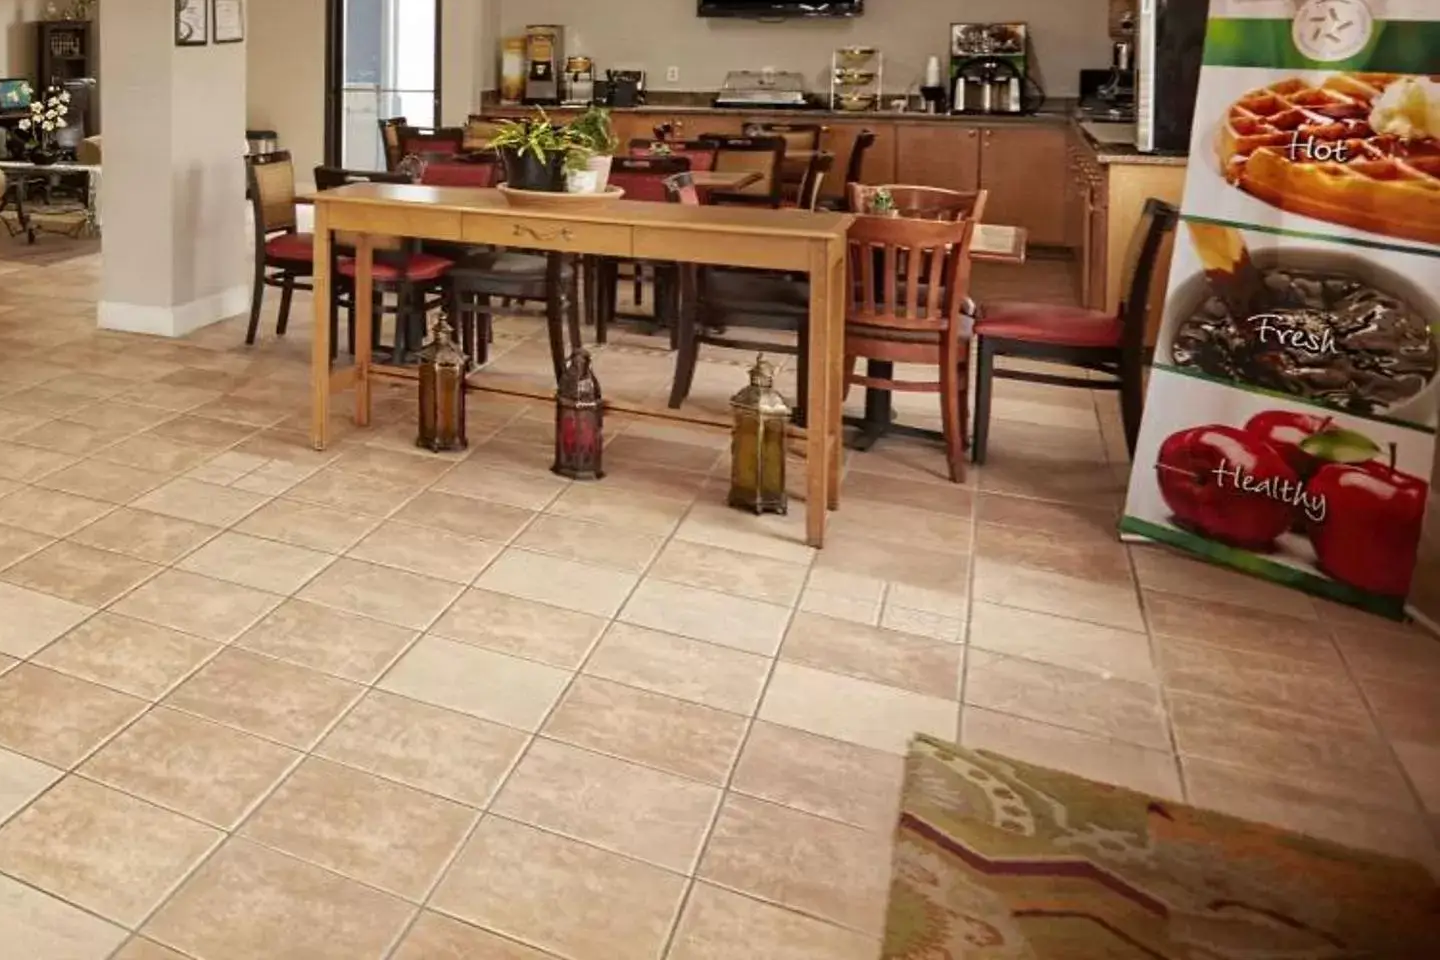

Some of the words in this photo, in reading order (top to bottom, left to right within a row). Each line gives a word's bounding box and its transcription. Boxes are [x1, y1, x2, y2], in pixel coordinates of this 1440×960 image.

[1282, 131, 1348, 162] Hot
[1247, 313, 1339, 356] Fresh
[1211, 458, 1328, 522] Healthy
